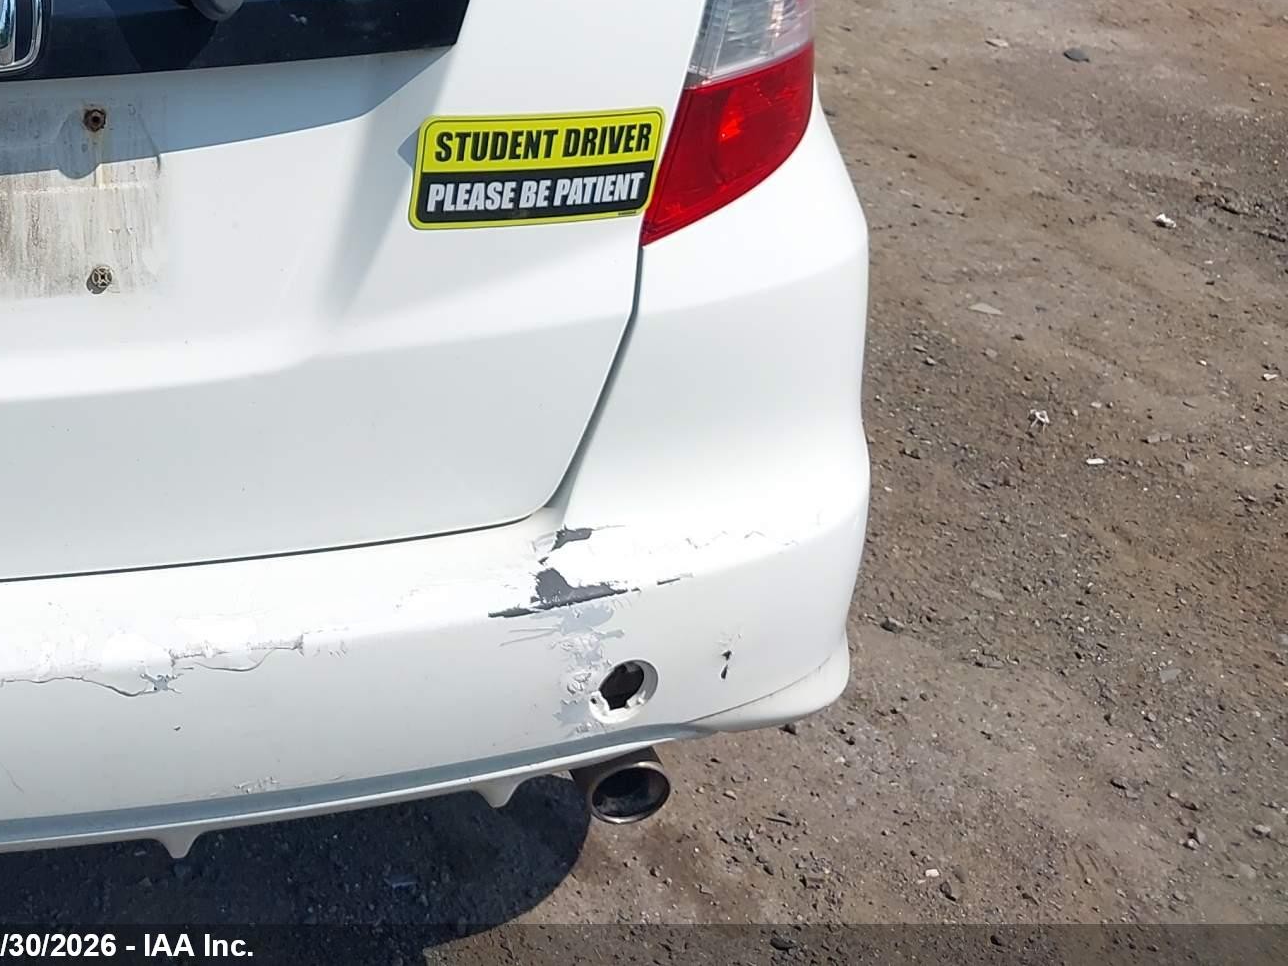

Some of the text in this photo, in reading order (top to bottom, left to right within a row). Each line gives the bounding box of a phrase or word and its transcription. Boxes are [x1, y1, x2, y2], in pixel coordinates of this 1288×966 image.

[435, 123, 652, 162] STUDENT DRIVER
[426, 172, 645, 212] PLEASE BE PATIENT
